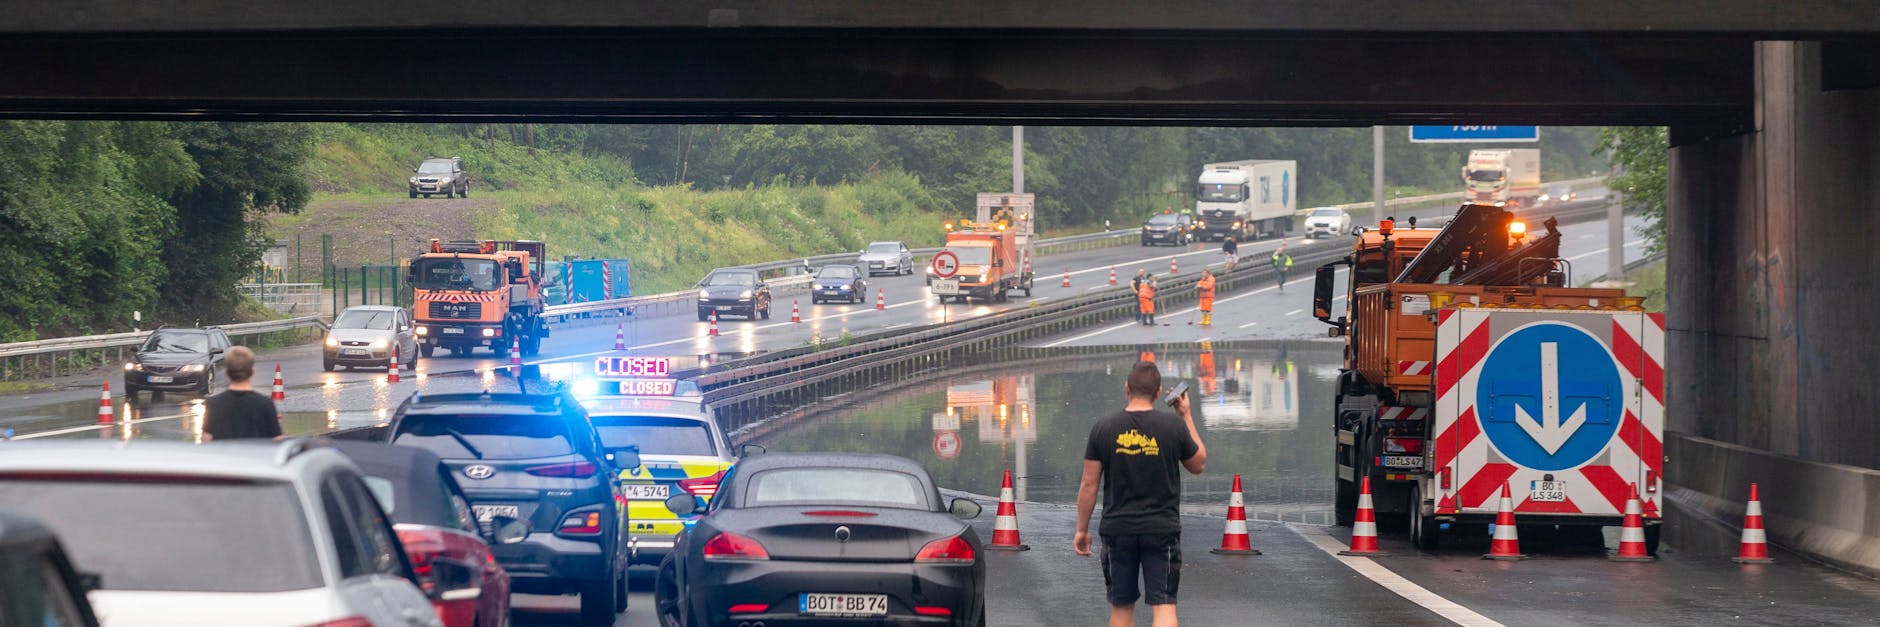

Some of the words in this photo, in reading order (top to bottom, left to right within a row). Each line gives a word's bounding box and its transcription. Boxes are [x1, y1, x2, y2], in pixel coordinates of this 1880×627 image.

[595, 356, 670, 377] CLOSED
[620, 381, 672, 395] CLOSED
[1542, 482, 1554, 491] BO
[808, 596, 837, 610] BOT
[846, 597, 865, 611] BB
[868, 597, 886, 611] 74
